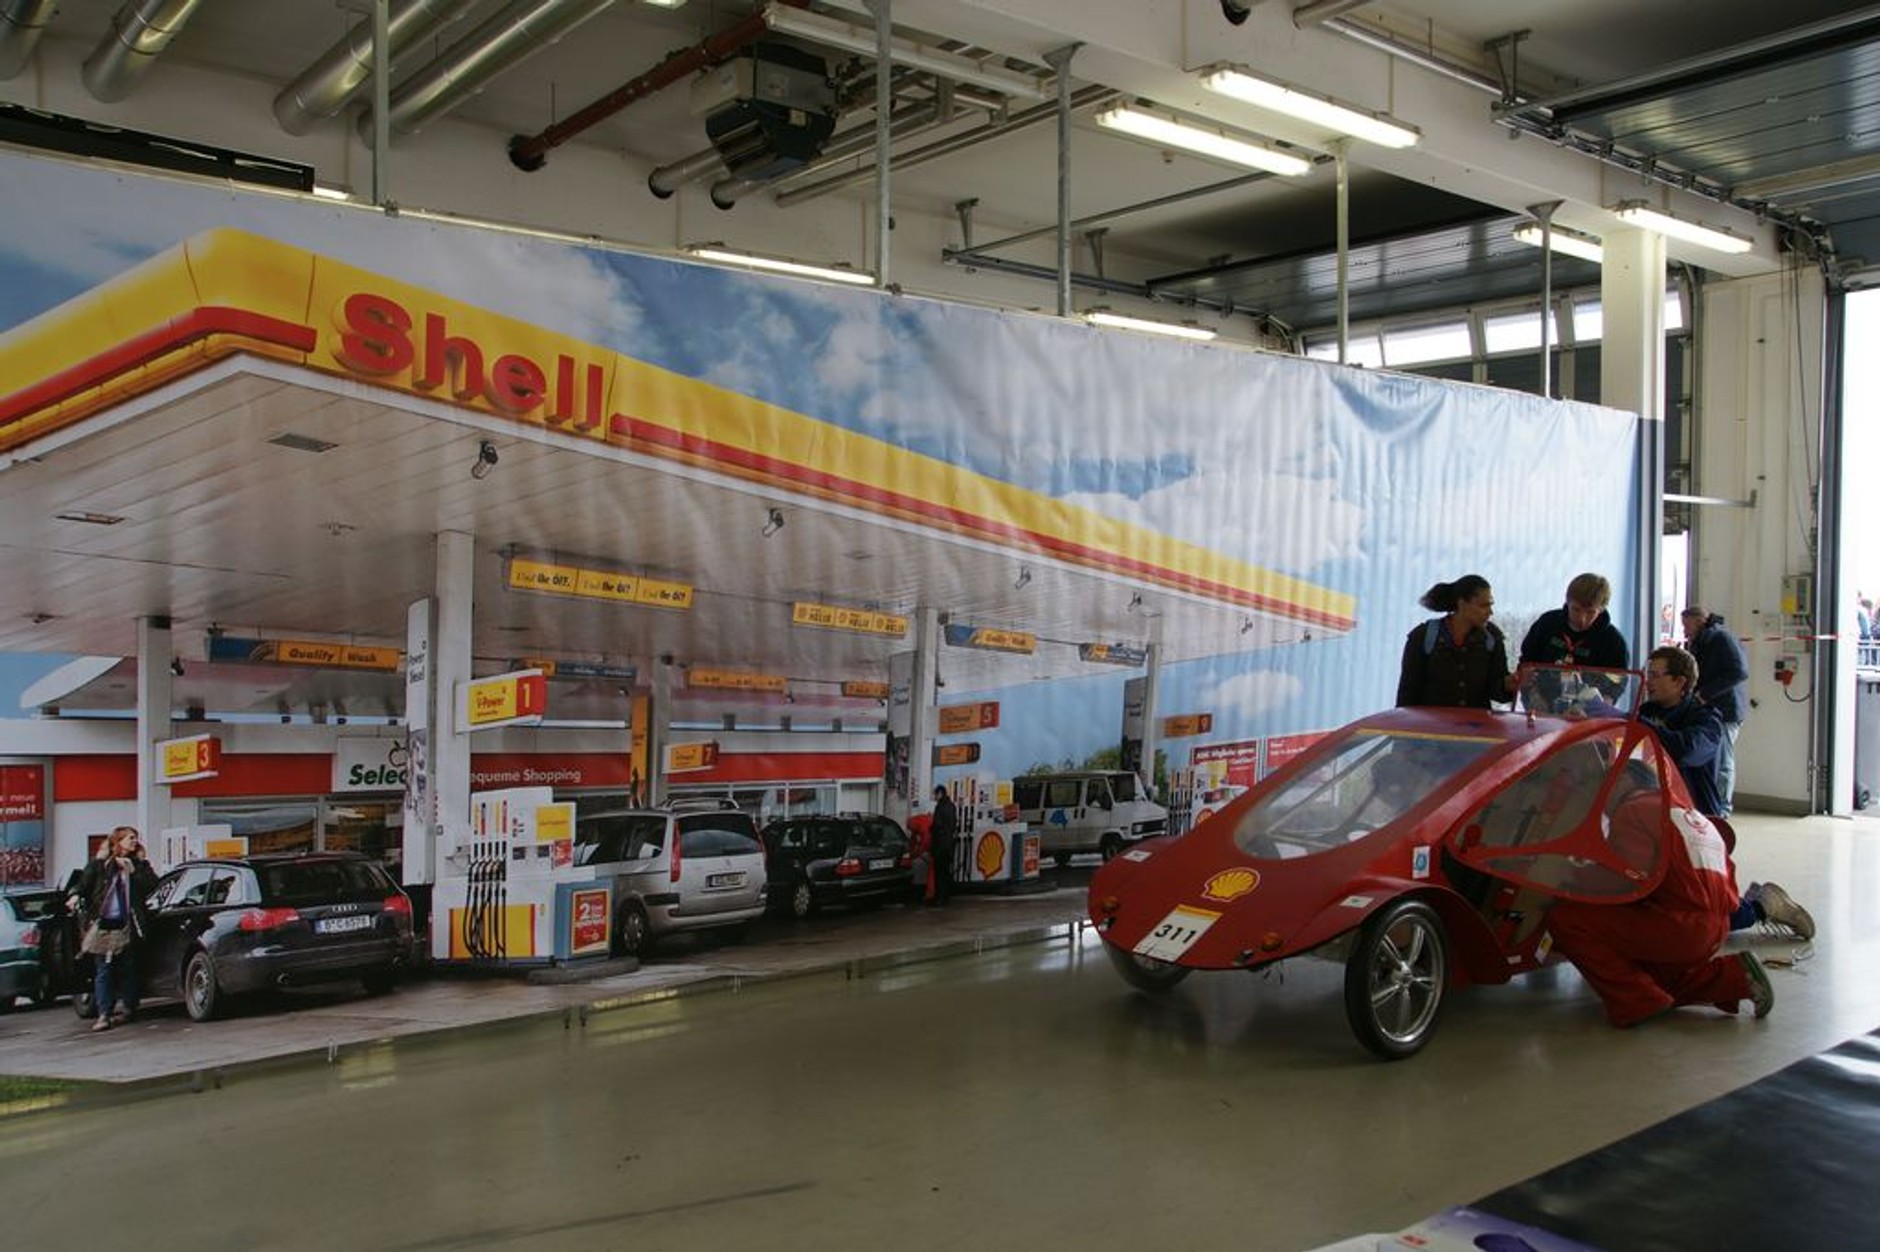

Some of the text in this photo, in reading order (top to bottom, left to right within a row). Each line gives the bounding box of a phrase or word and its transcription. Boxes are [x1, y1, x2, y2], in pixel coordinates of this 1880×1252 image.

[340, 293, 604, 430] Shell
[289, 648, 377, 662] Quality Wash
[523, 683, 531, 708] 1
[200, 742, 209, 768] 3
[523, 768, 582, 784] Shopping
[1154, 924, 1198, 944] 311
